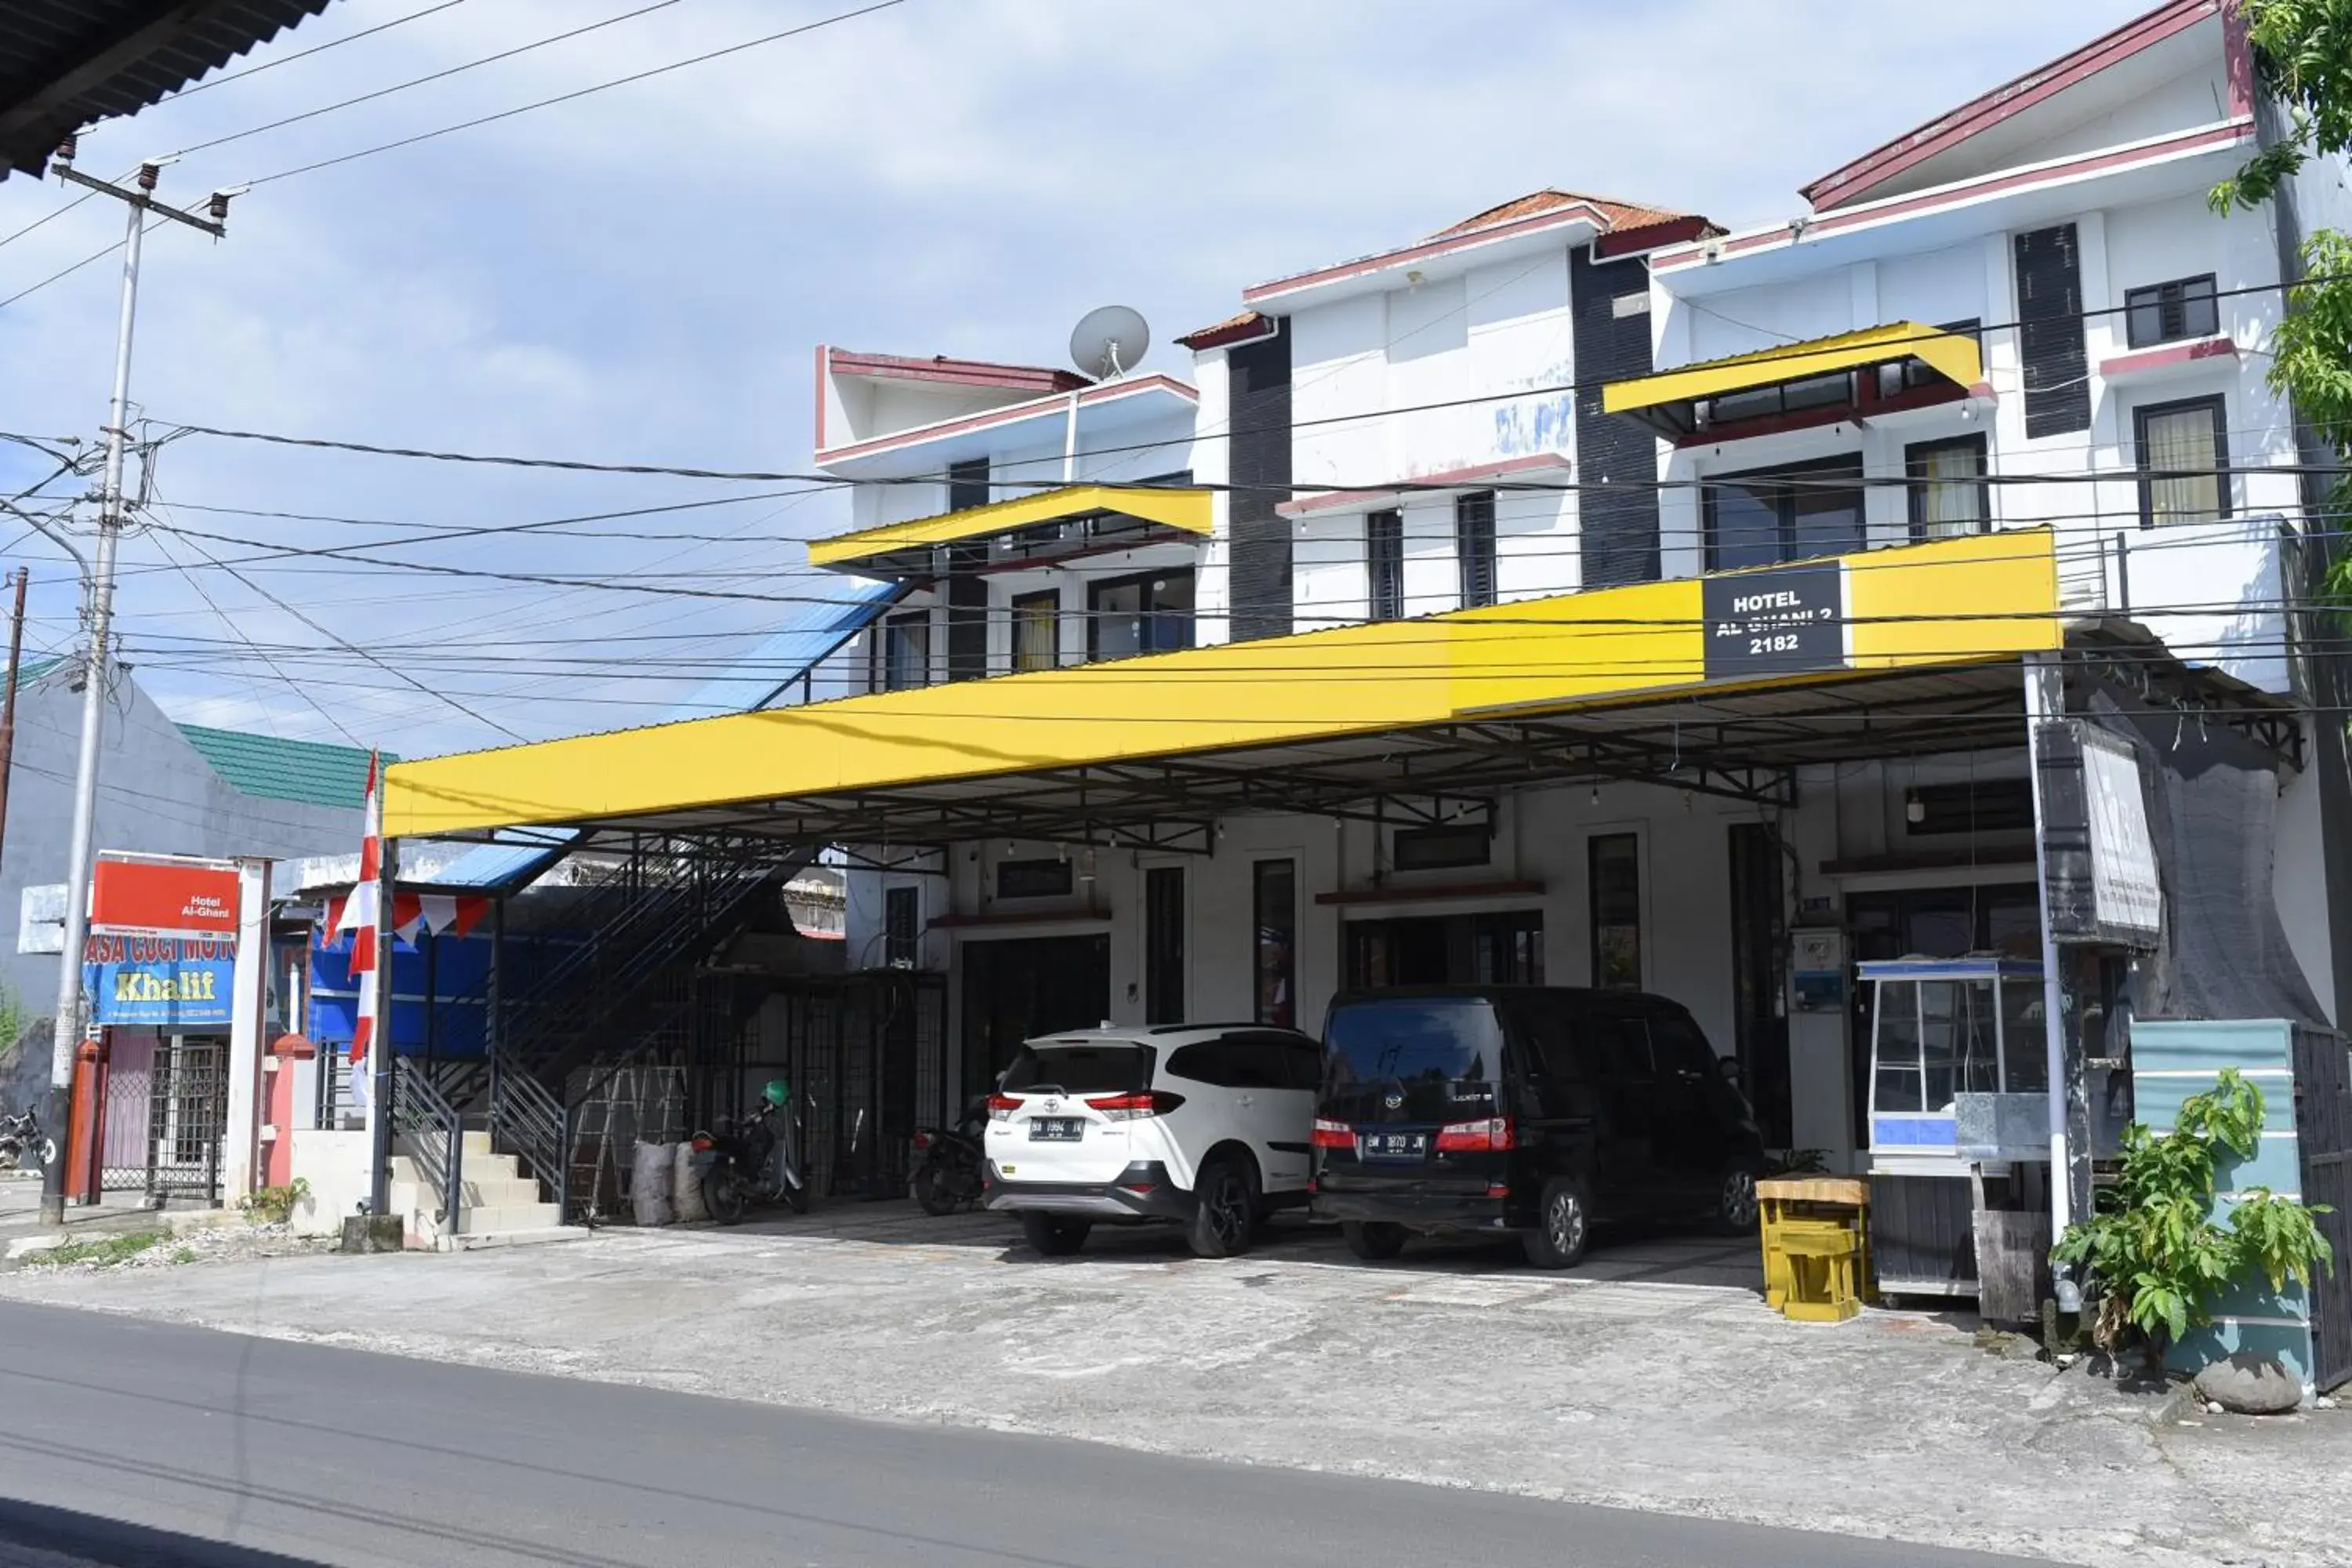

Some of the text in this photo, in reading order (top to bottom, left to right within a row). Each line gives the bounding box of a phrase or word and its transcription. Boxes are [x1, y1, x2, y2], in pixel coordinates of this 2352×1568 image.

[1733, 590, 1801, 613] HOTEL
[1716, 622, 1743, 637] AL
[1750, 634, 1799, 655] 2182
[191, 895, 220, 907] Hotel
[181, 906, 230, 918] Al-Ghani
[84, 934, 125, 964] ASA
[114, 971, 216, 1003] Khalif
